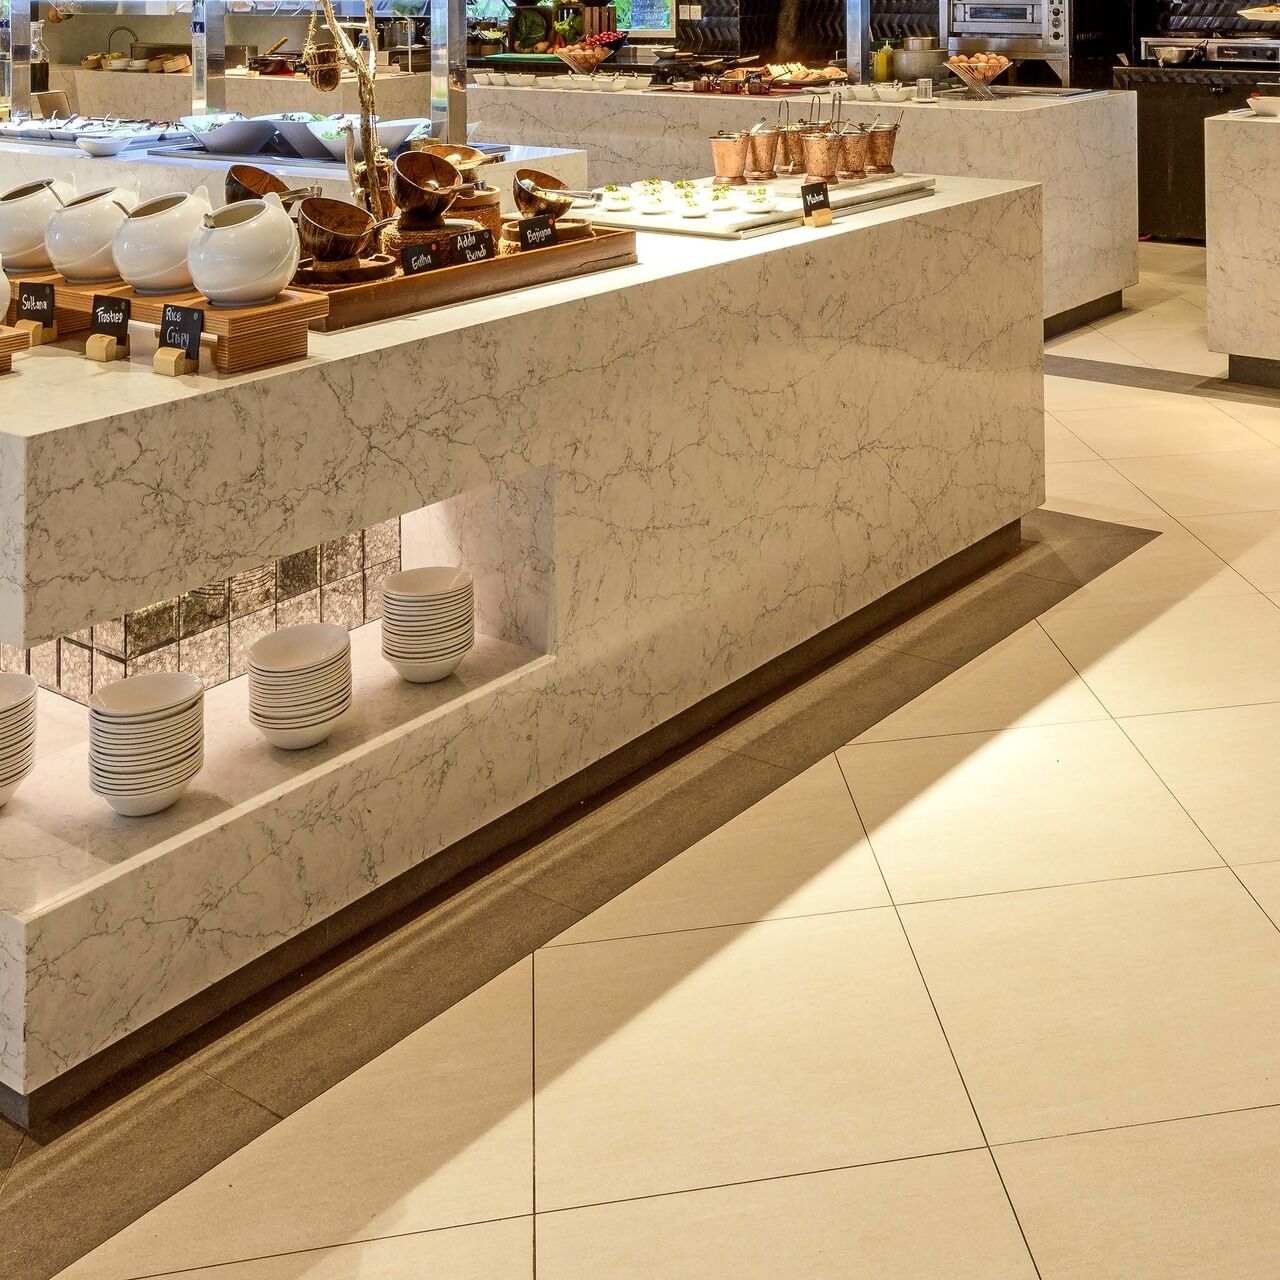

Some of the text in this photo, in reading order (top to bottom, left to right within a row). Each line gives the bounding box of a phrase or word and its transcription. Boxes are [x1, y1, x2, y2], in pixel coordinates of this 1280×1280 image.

[21, 294, 48, 311] Sultana
[166, 307, 182, 321] Rice
[166, 326, 190, 350] Crispy
